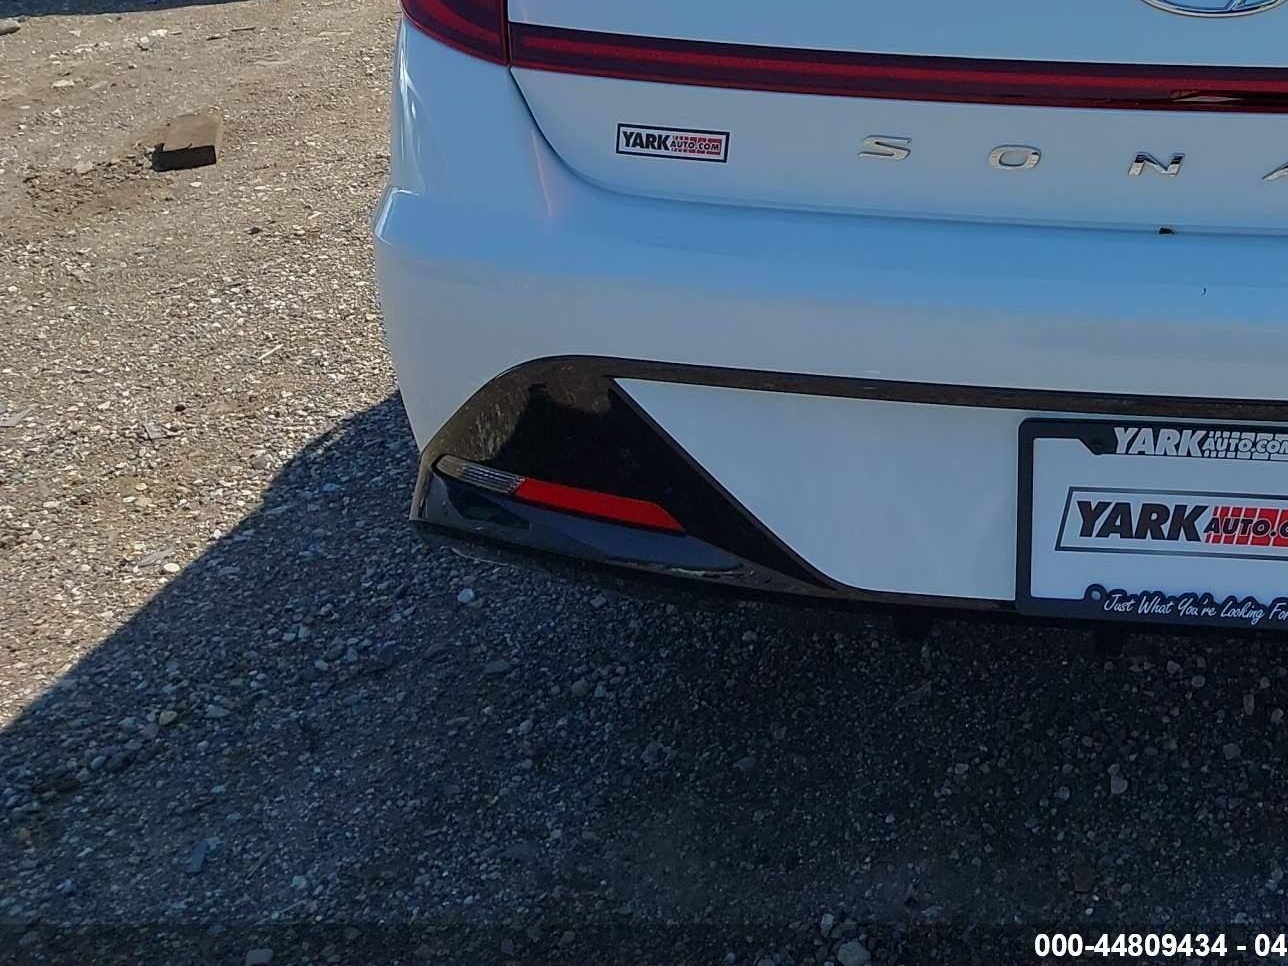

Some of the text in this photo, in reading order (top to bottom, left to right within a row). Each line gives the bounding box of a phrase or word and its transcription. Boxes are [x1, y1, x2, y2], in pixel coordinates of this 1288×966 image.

[1103, 594, 1136, 612] Just
[1137, 595, 1175, 615] What
[1177, 597, 1217, 618] You're
[1220, 600, 1265, 625] Looking
